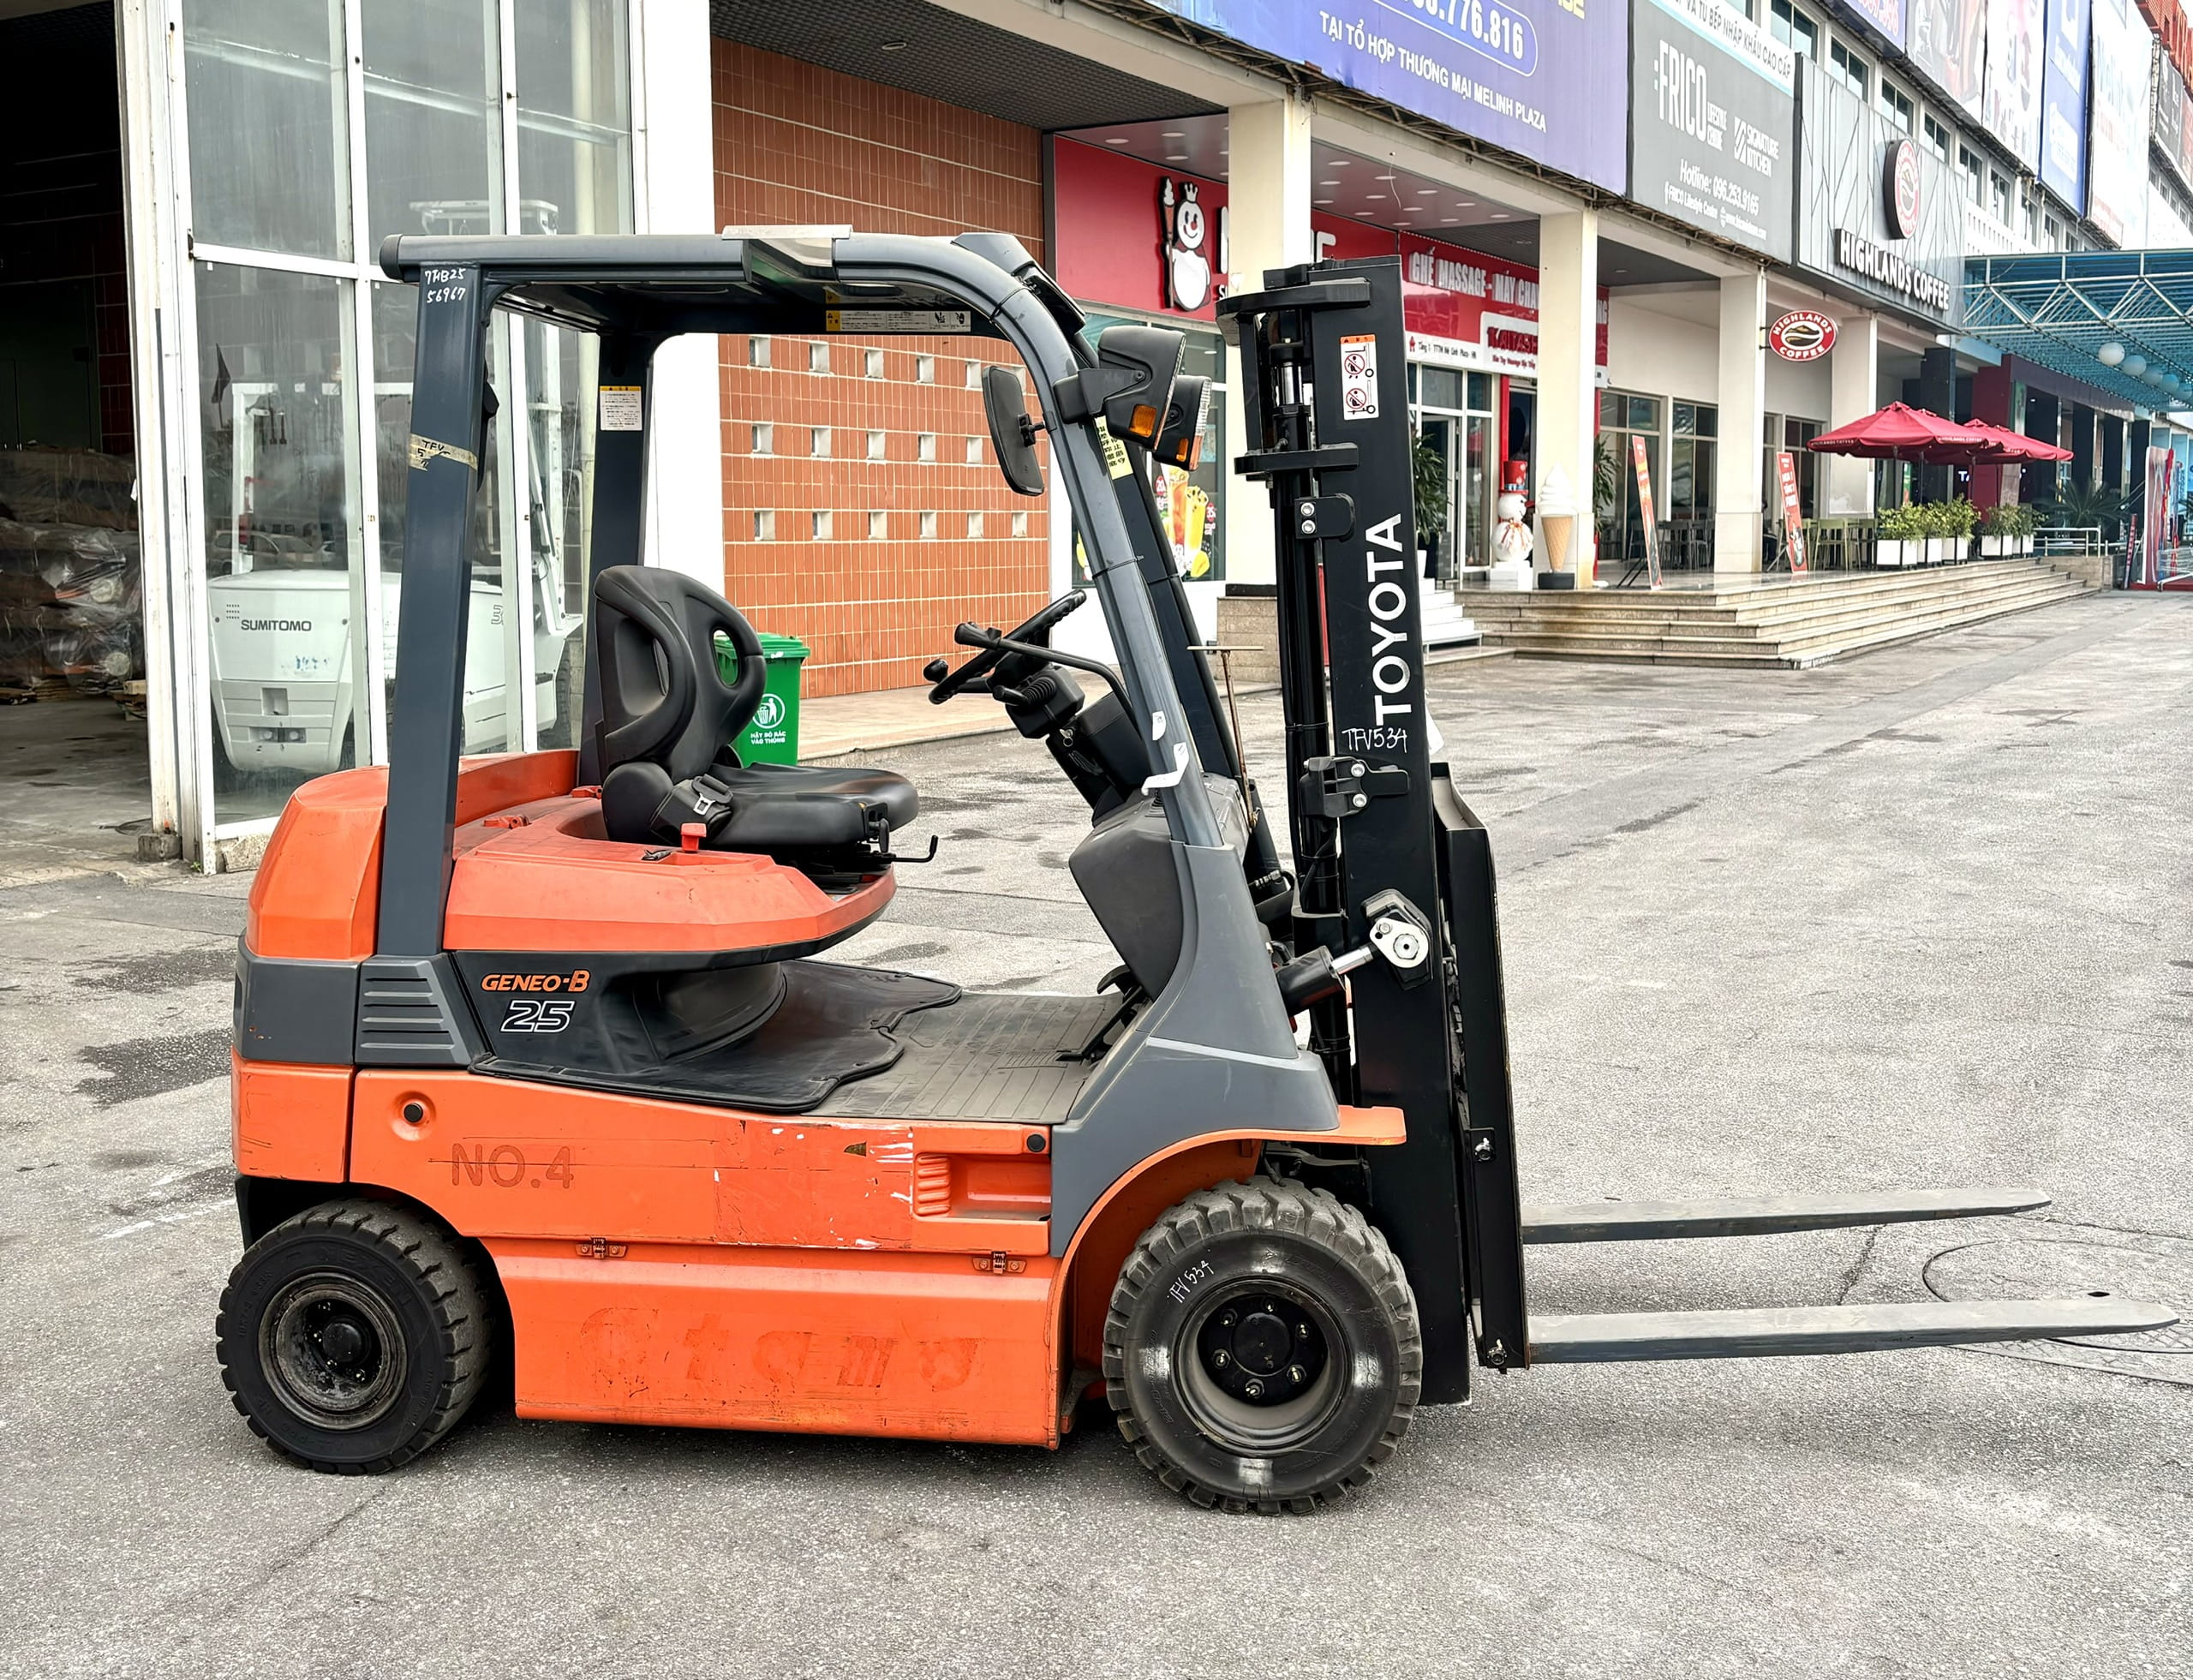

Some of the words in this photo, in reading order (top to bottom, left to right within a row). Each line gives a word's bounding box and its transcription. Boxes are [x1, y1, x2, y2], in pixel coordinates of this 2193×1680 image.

[1319, 11, 1342, 42] TẠI
[1346, 19, 1365, 51] TỔ
[1368, 33, 1395, 64] HỢP
[1451, 73, 1472, 100] MẠI
[1474, 87, 1513, 117] MELINH
[1515, 104, 1546, 133] PLAZA
[1762, 46, 1777, 71] CAO
[1680, 158, 1712, 194] Hotline:
[1437, 259, 1487, 298] MASSAGE
[1840, 229, 1912, 296] HIGHLANDS
[1913, 268, 1951, 311] COFFEE
[427, 286, 466, 303] 56967
[1772, 313, 1832, 336] HIGHLANDS
[1779, 345, 1826, 360] COFFEE
[241, 619, 313, 632] SUMITOMO
[1365, 513, 1412, 726] TOYOTA
[500, 1000, 576, 1033] 25
[451, 1143, 574, 1190] NO.4
